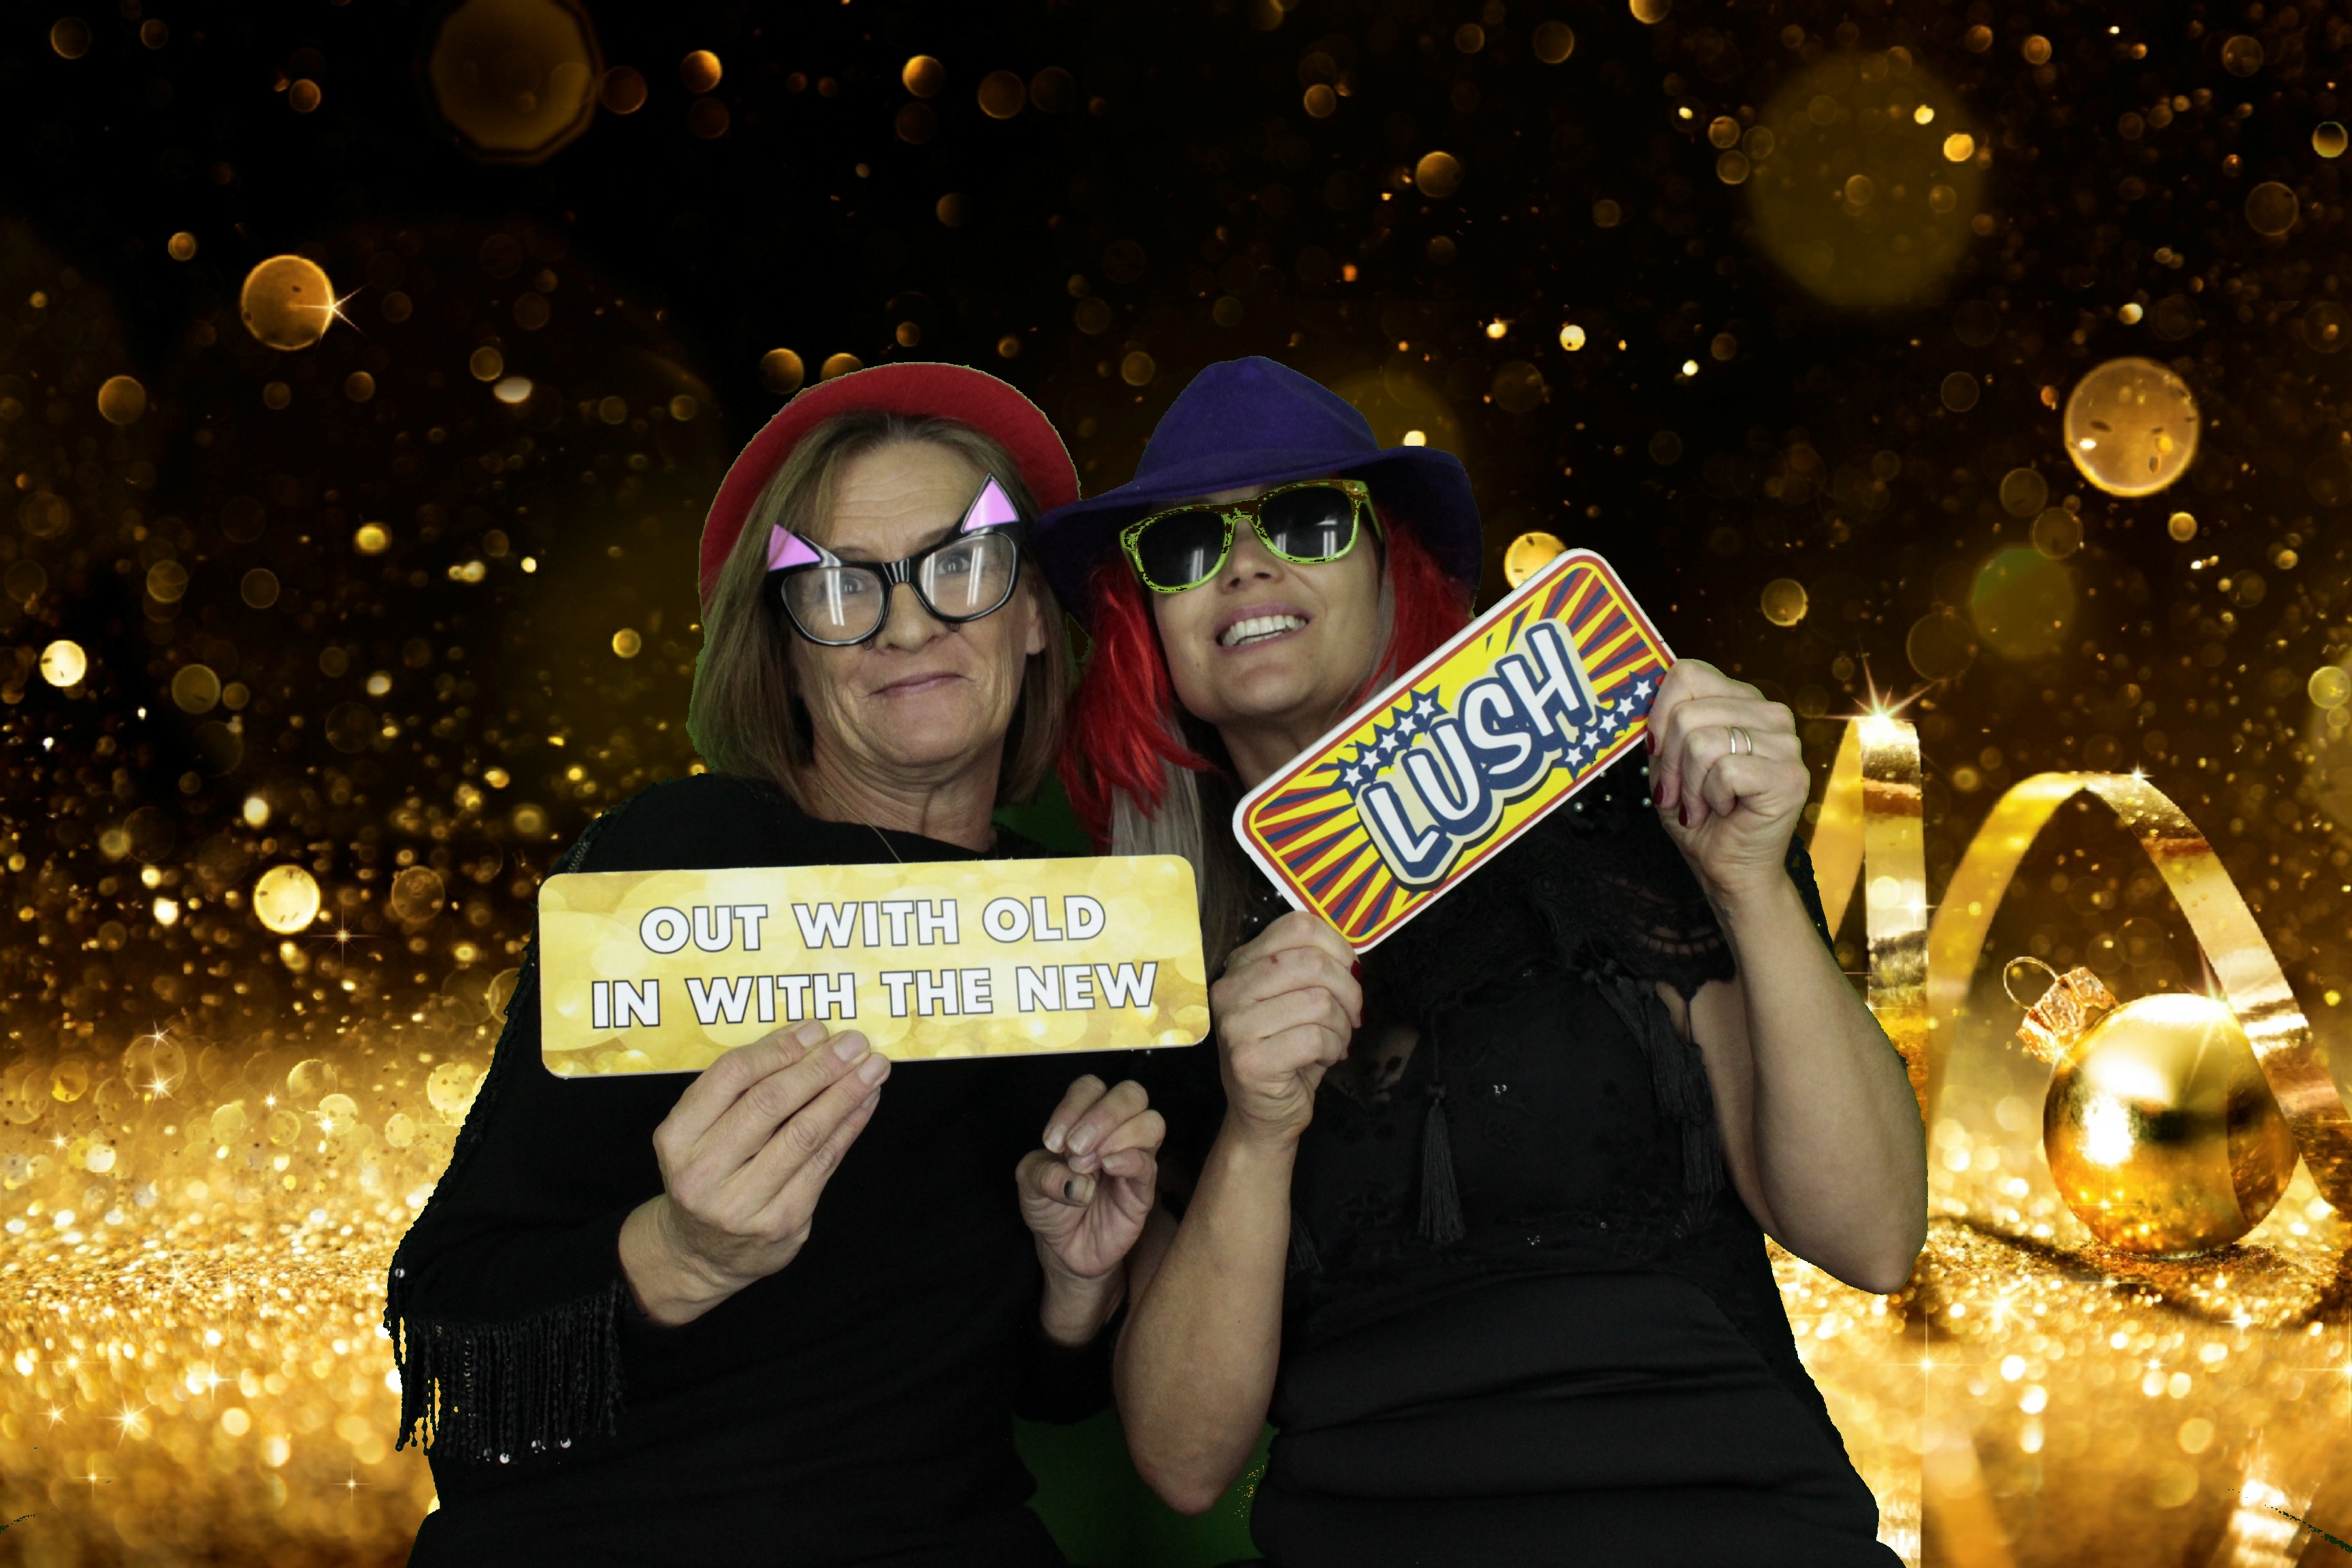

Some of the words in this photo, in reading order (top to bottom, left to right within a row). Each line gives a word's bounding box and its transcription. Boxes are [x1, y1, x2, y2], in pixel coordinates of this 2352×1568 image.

[1361, 620, 1595, 879] LUSH
[639, 903, 768, 953] OUT
[791, 899, 960, 950] WITH
[981, 894, 1106, 944] OLD
[591, 979, 661, 1029] IN
[684, 973, 857, 1026] WITH
[880, 967, 994, 1017] THE
[1017, 961, 1159, 1013] NEW
